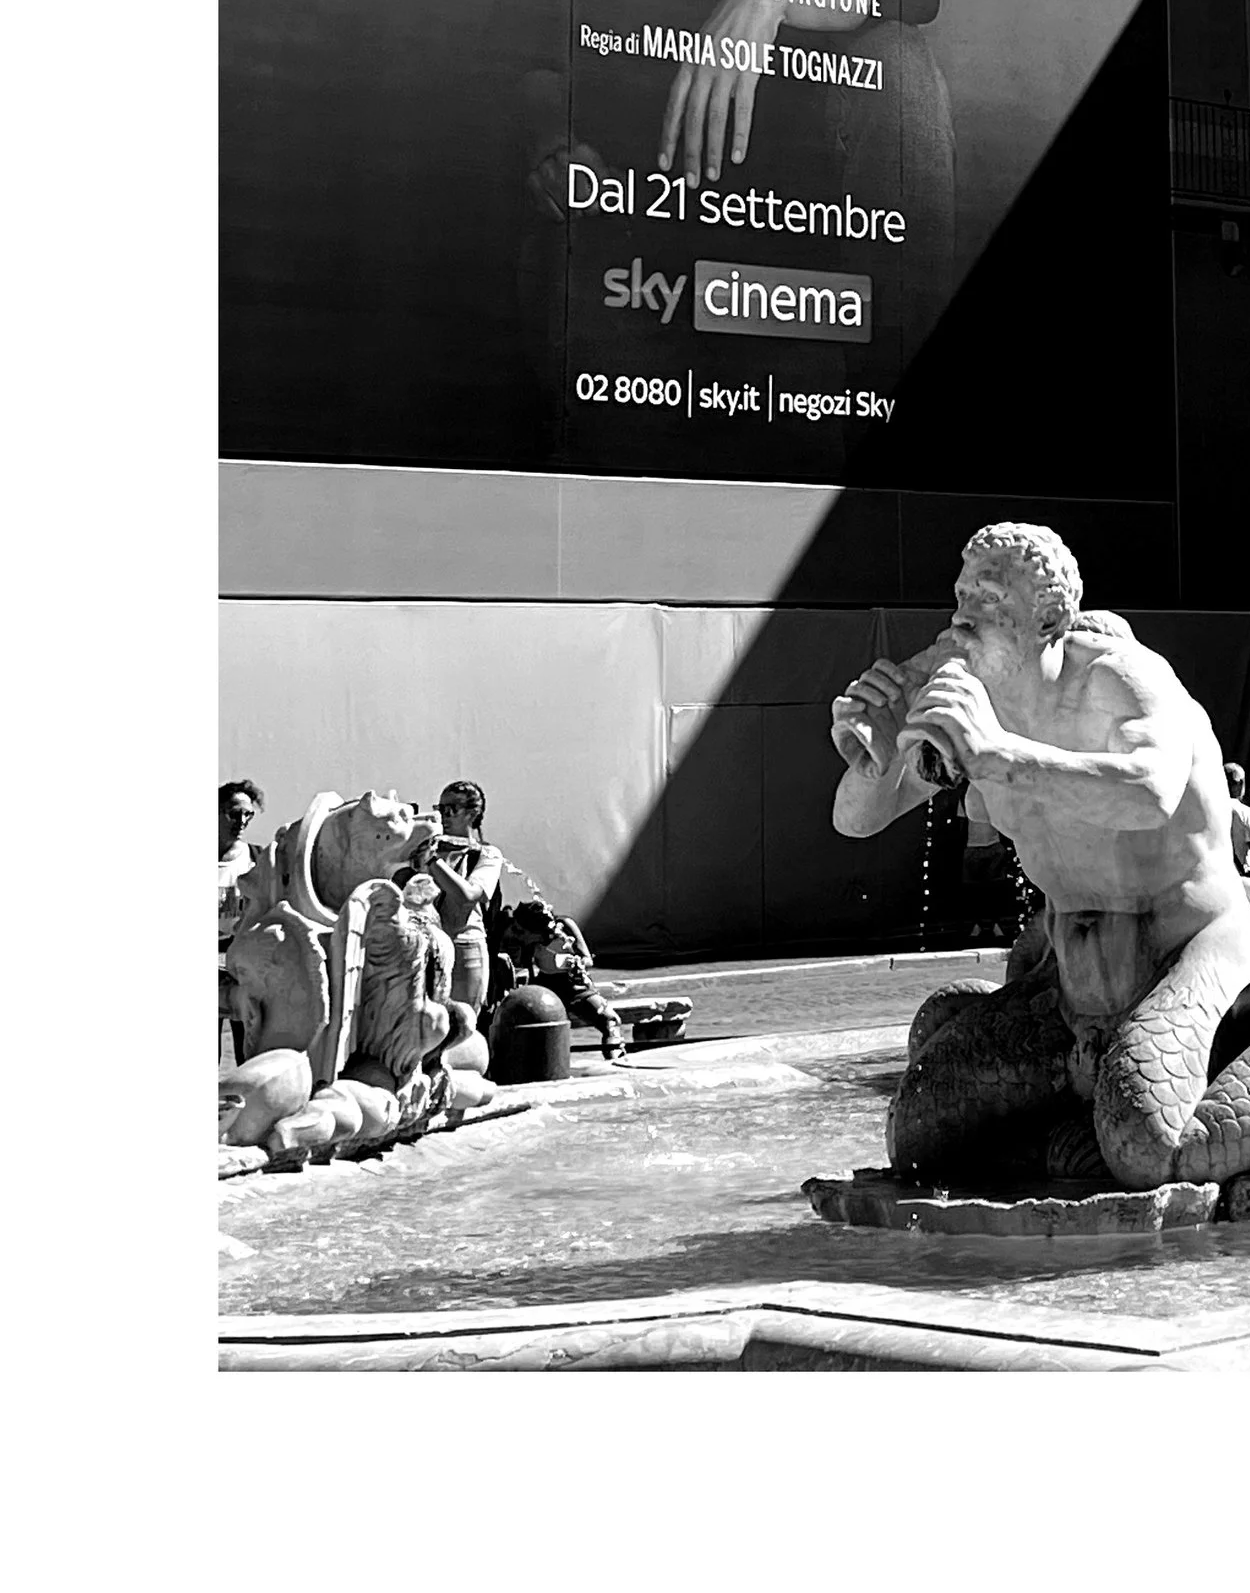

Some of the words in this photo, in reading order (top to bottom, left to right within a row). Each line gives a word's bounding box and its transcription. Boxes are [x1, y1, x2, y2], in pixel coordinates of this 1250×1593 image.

[580, 24, 622, 56] Regia
[625, 32, 640, 55] di
[643, 25, 717, 67] MARIA
[720, 37, 775, 75] SOLE
[779, 45, 883, 90] TOGNAZZI
[568, 163, 634, 215] Dal
[646, 173, 685, 220] 21
[699, 188, 906, 243] settembre
[603, 257, 687, 324] sky
[704, 270, 861, 326] cinema
[576, 373, 609, 402] 02
[614, 375, 682, 406] 8080
[699, 381, 761, 417] sky.it
[779, 389, 851, 421] negozi
[855, 391, 896, 423] Sky
